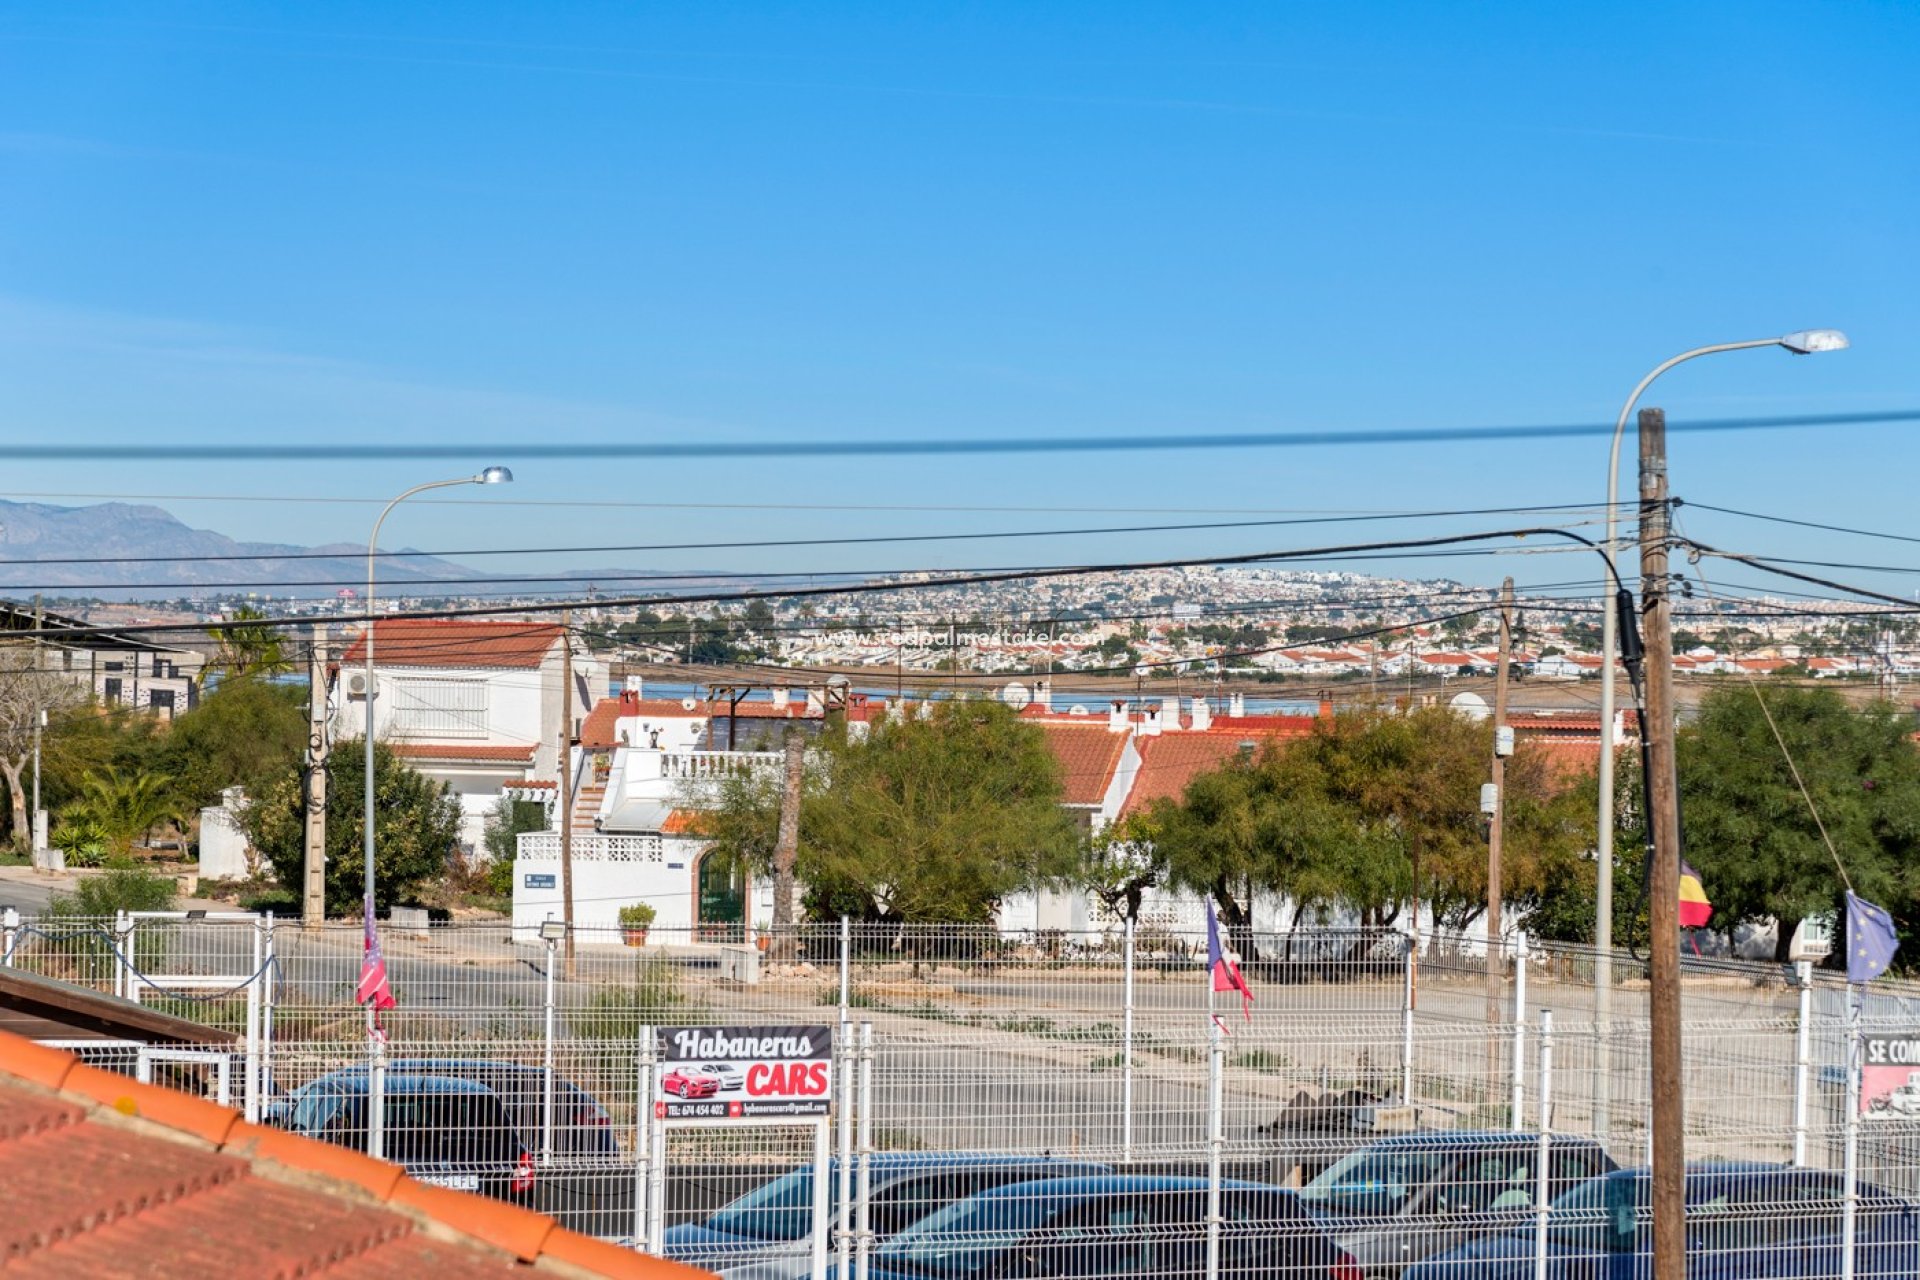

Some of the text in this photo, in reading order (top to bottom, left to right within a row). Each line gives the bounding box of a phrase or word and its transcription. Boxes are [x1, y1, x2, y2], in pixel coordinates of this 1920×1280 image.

[675, 1029, 813, 1058] Habaneras
[1868, 1040, 1886, 1062] SE
[746, 1062, 828, 1096] CARS
